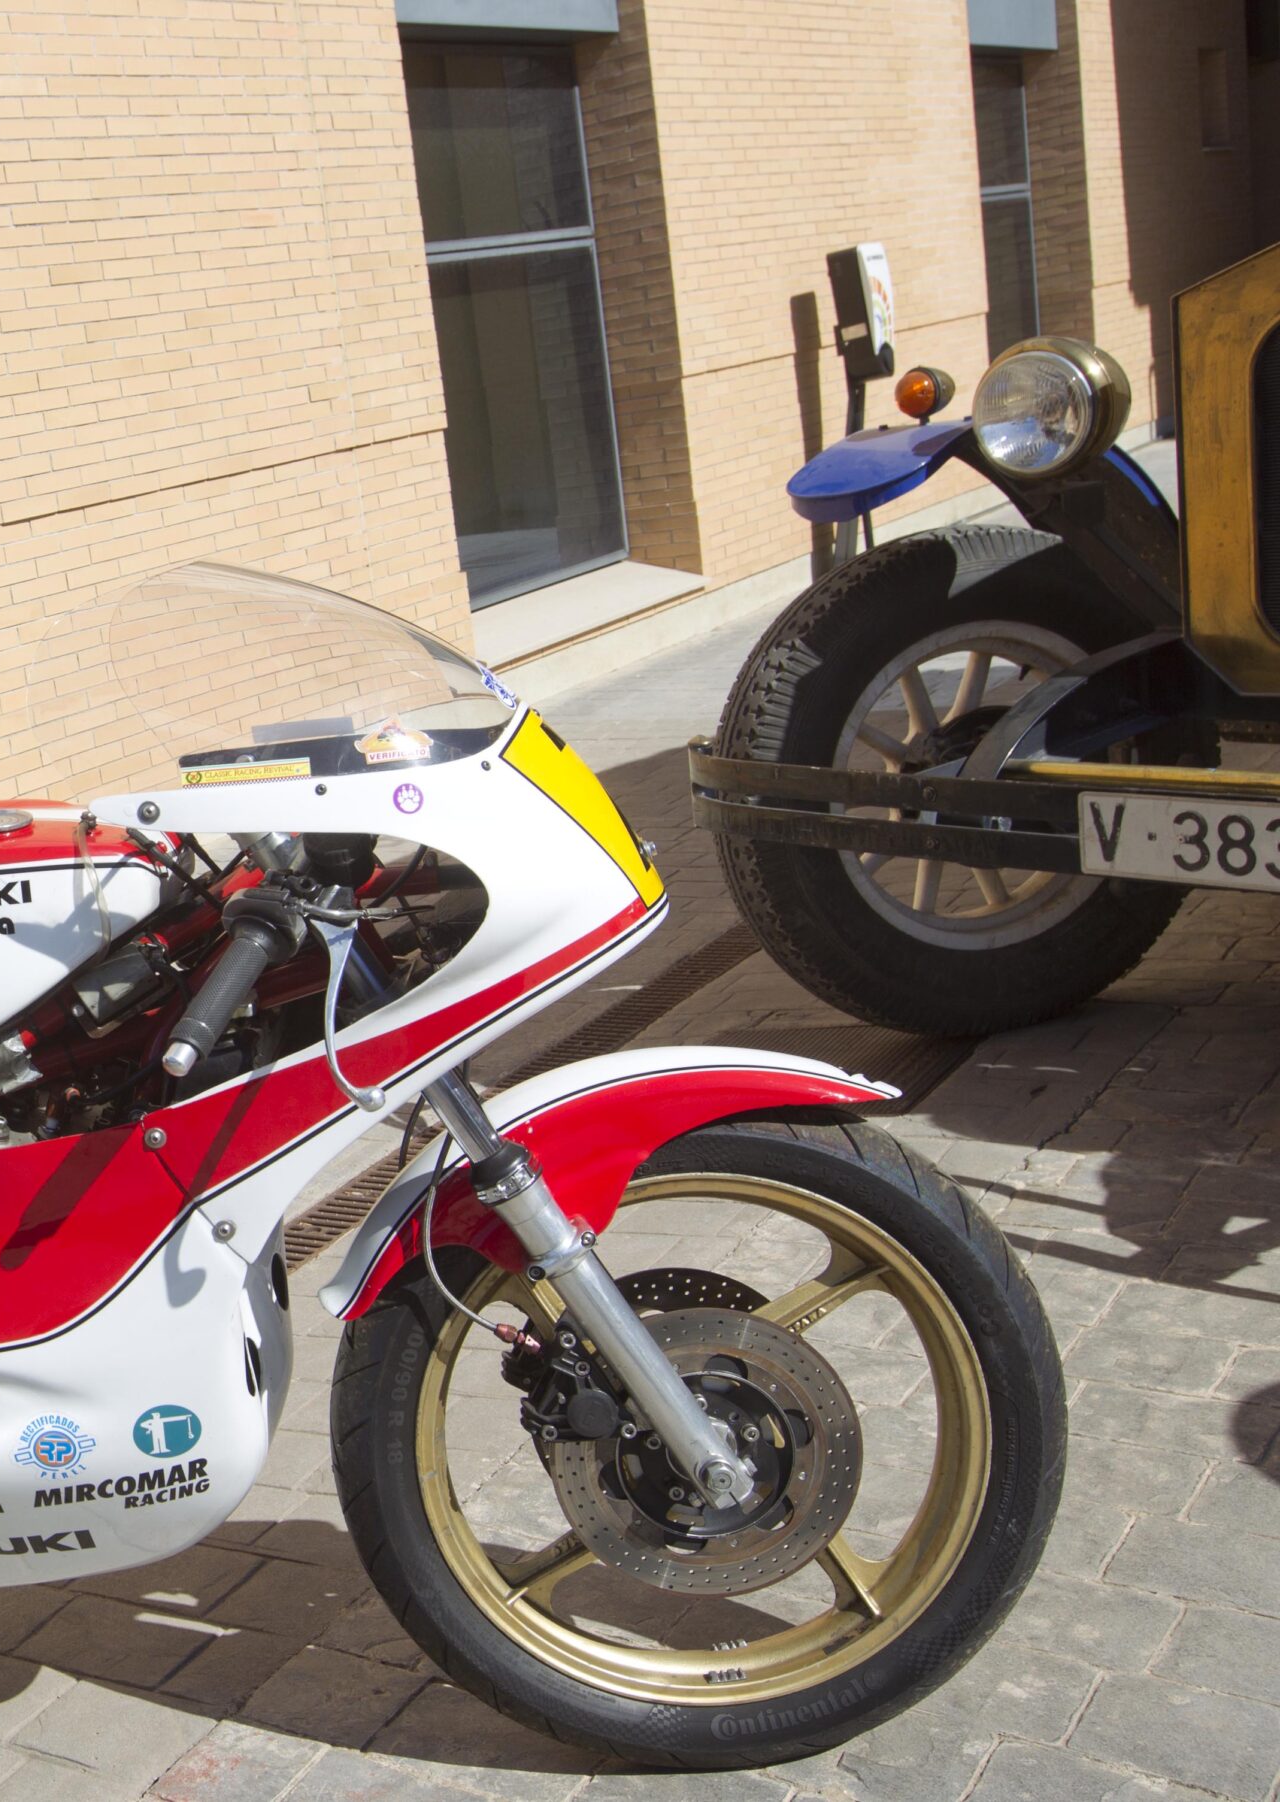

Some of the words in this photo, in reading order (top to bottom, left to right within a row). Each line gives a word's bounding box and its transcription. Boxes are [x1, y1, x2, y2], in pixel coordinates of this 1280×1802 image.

[369, 749, 426, 760] VERIFICTO
[204, 770, 232, 779] CLASSIC
[264, 765, 294, 774] REVIVAL
[1090, 801, 1126, 862] V
[20, 1414, 80, 1443] RECTIFICADOS
[40, 1441, 72, 1462] RP
[34, 1458, 208, 1508] MIRCOMAR
[124, 1478, 211, 1510] RACING
[710, 1679, 866, 1741] Continental
